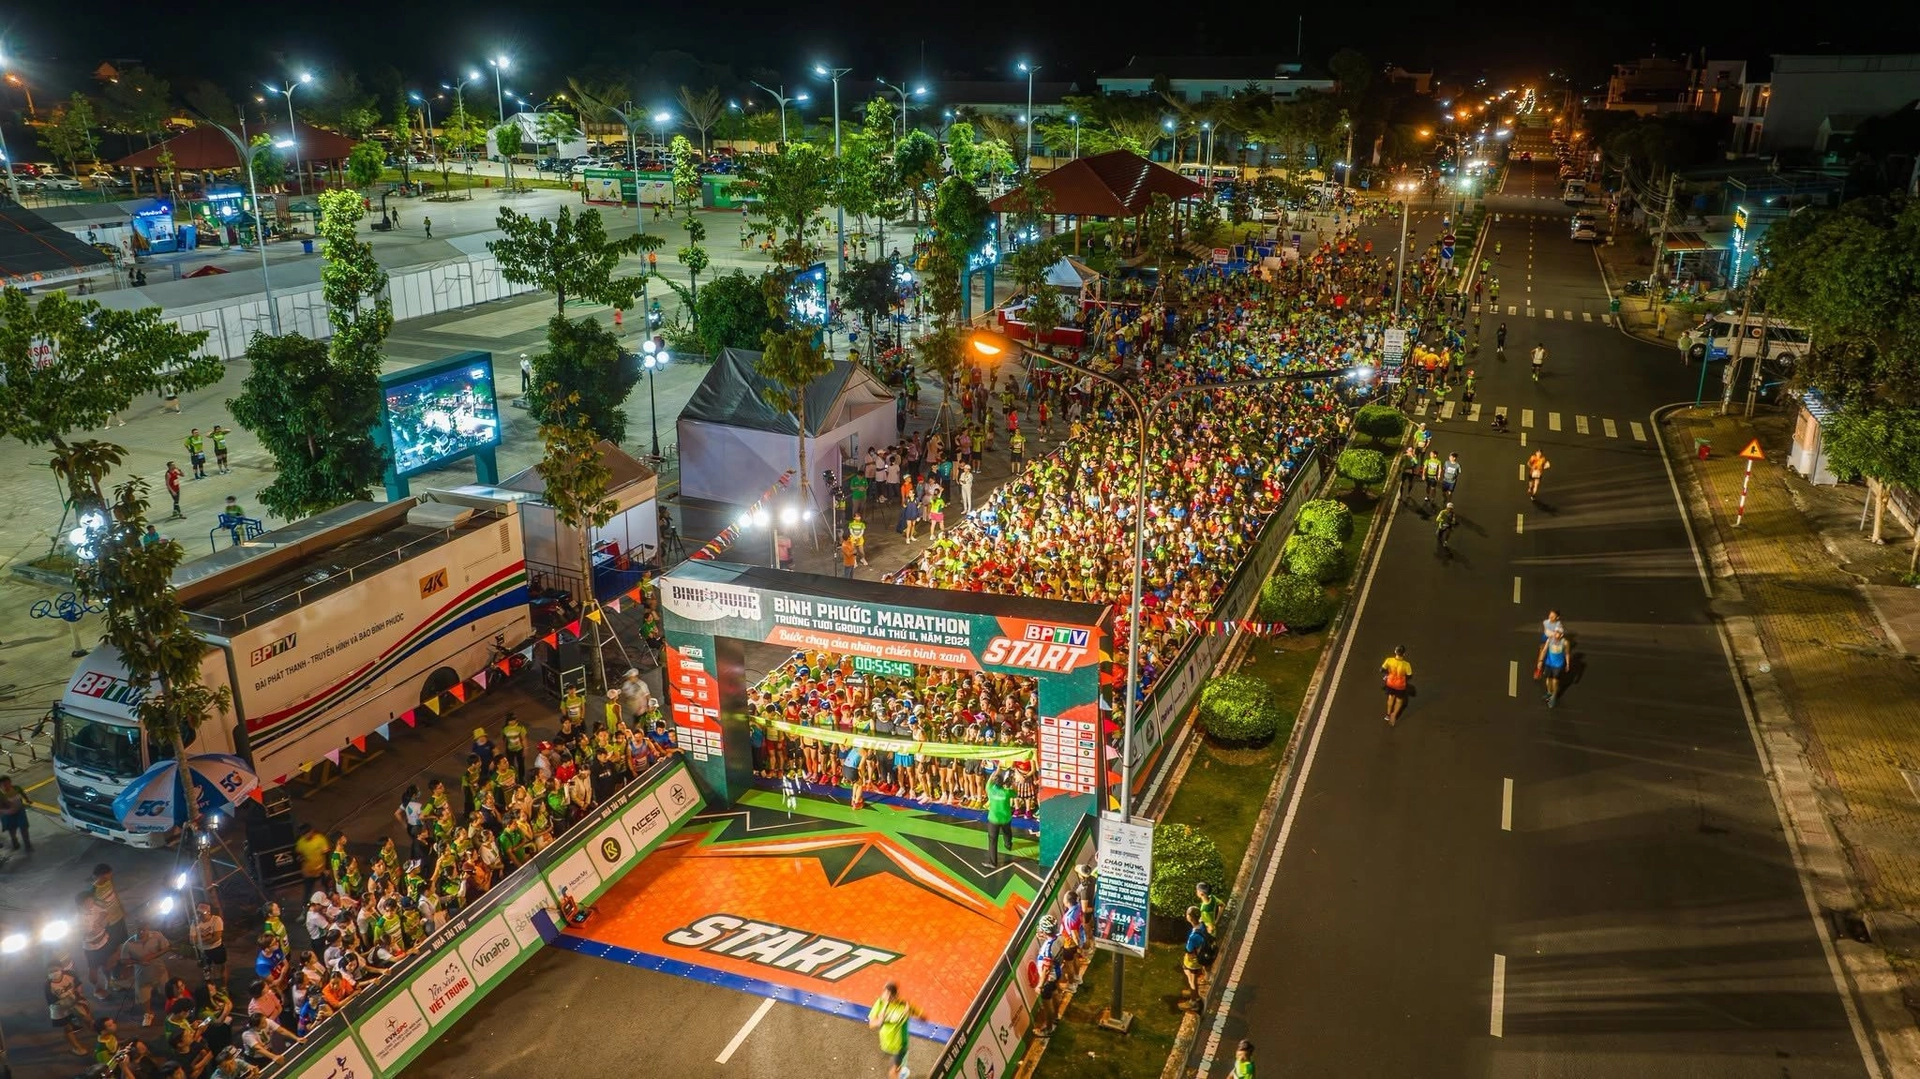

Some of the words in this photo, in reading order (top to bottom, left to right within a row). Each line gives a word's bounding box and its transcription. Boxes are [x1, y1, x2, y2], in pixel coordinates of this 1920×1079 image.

[423, 571, 444, 593] 4K
[774, 596, 812, 616] BÌNH
[817, 603, 871, 624] PHƯỚC
[877, 611, 970, 635] MARATHON
[774, 614, 810, 627] TRƯỜNG
[812, 619, 832, 630] TƯƠI
[835, 622, 866, 635] GROUP
[868, 626, 885, 637] LẦN
[888, 629, 907, 640] THỨ
[921, 632, 942, 644] NĂM
[945, 636, 970, 646] 2024
[252, 633, 297, 666] BPTV
[267, 668, 285, 686] PHÁT
[285, 659, 307, 676] THANH
[310, 643, 335, 664] TRUYỀN
[335, 638, 350, 653] HÌNH
[350, 632, 358, 645] VÀ
[372, 622, 385, 636] BÌNH
[385, 612, 405, 628] PHƯỚC
[780, 629, 805, 643] Bước
[805, 634, 829, 648] chạy
[831, 638, 849, 649] của
[851, 638, 882, 656] những
[885, 643, 911, 657] chiến
[939, 652, 967, 663] xanh
[1027, 625, 1087, 646] BPTV
[855, 656, 911, 676] 00:55:45
[983, 638, 1088, 671] START
[73, 672, 144, 706] BPTV
[475, 937, 510, 967] Vinahe
[666, 915, 903, 982] START
[445, 977, 469, 1001] TRUNG
